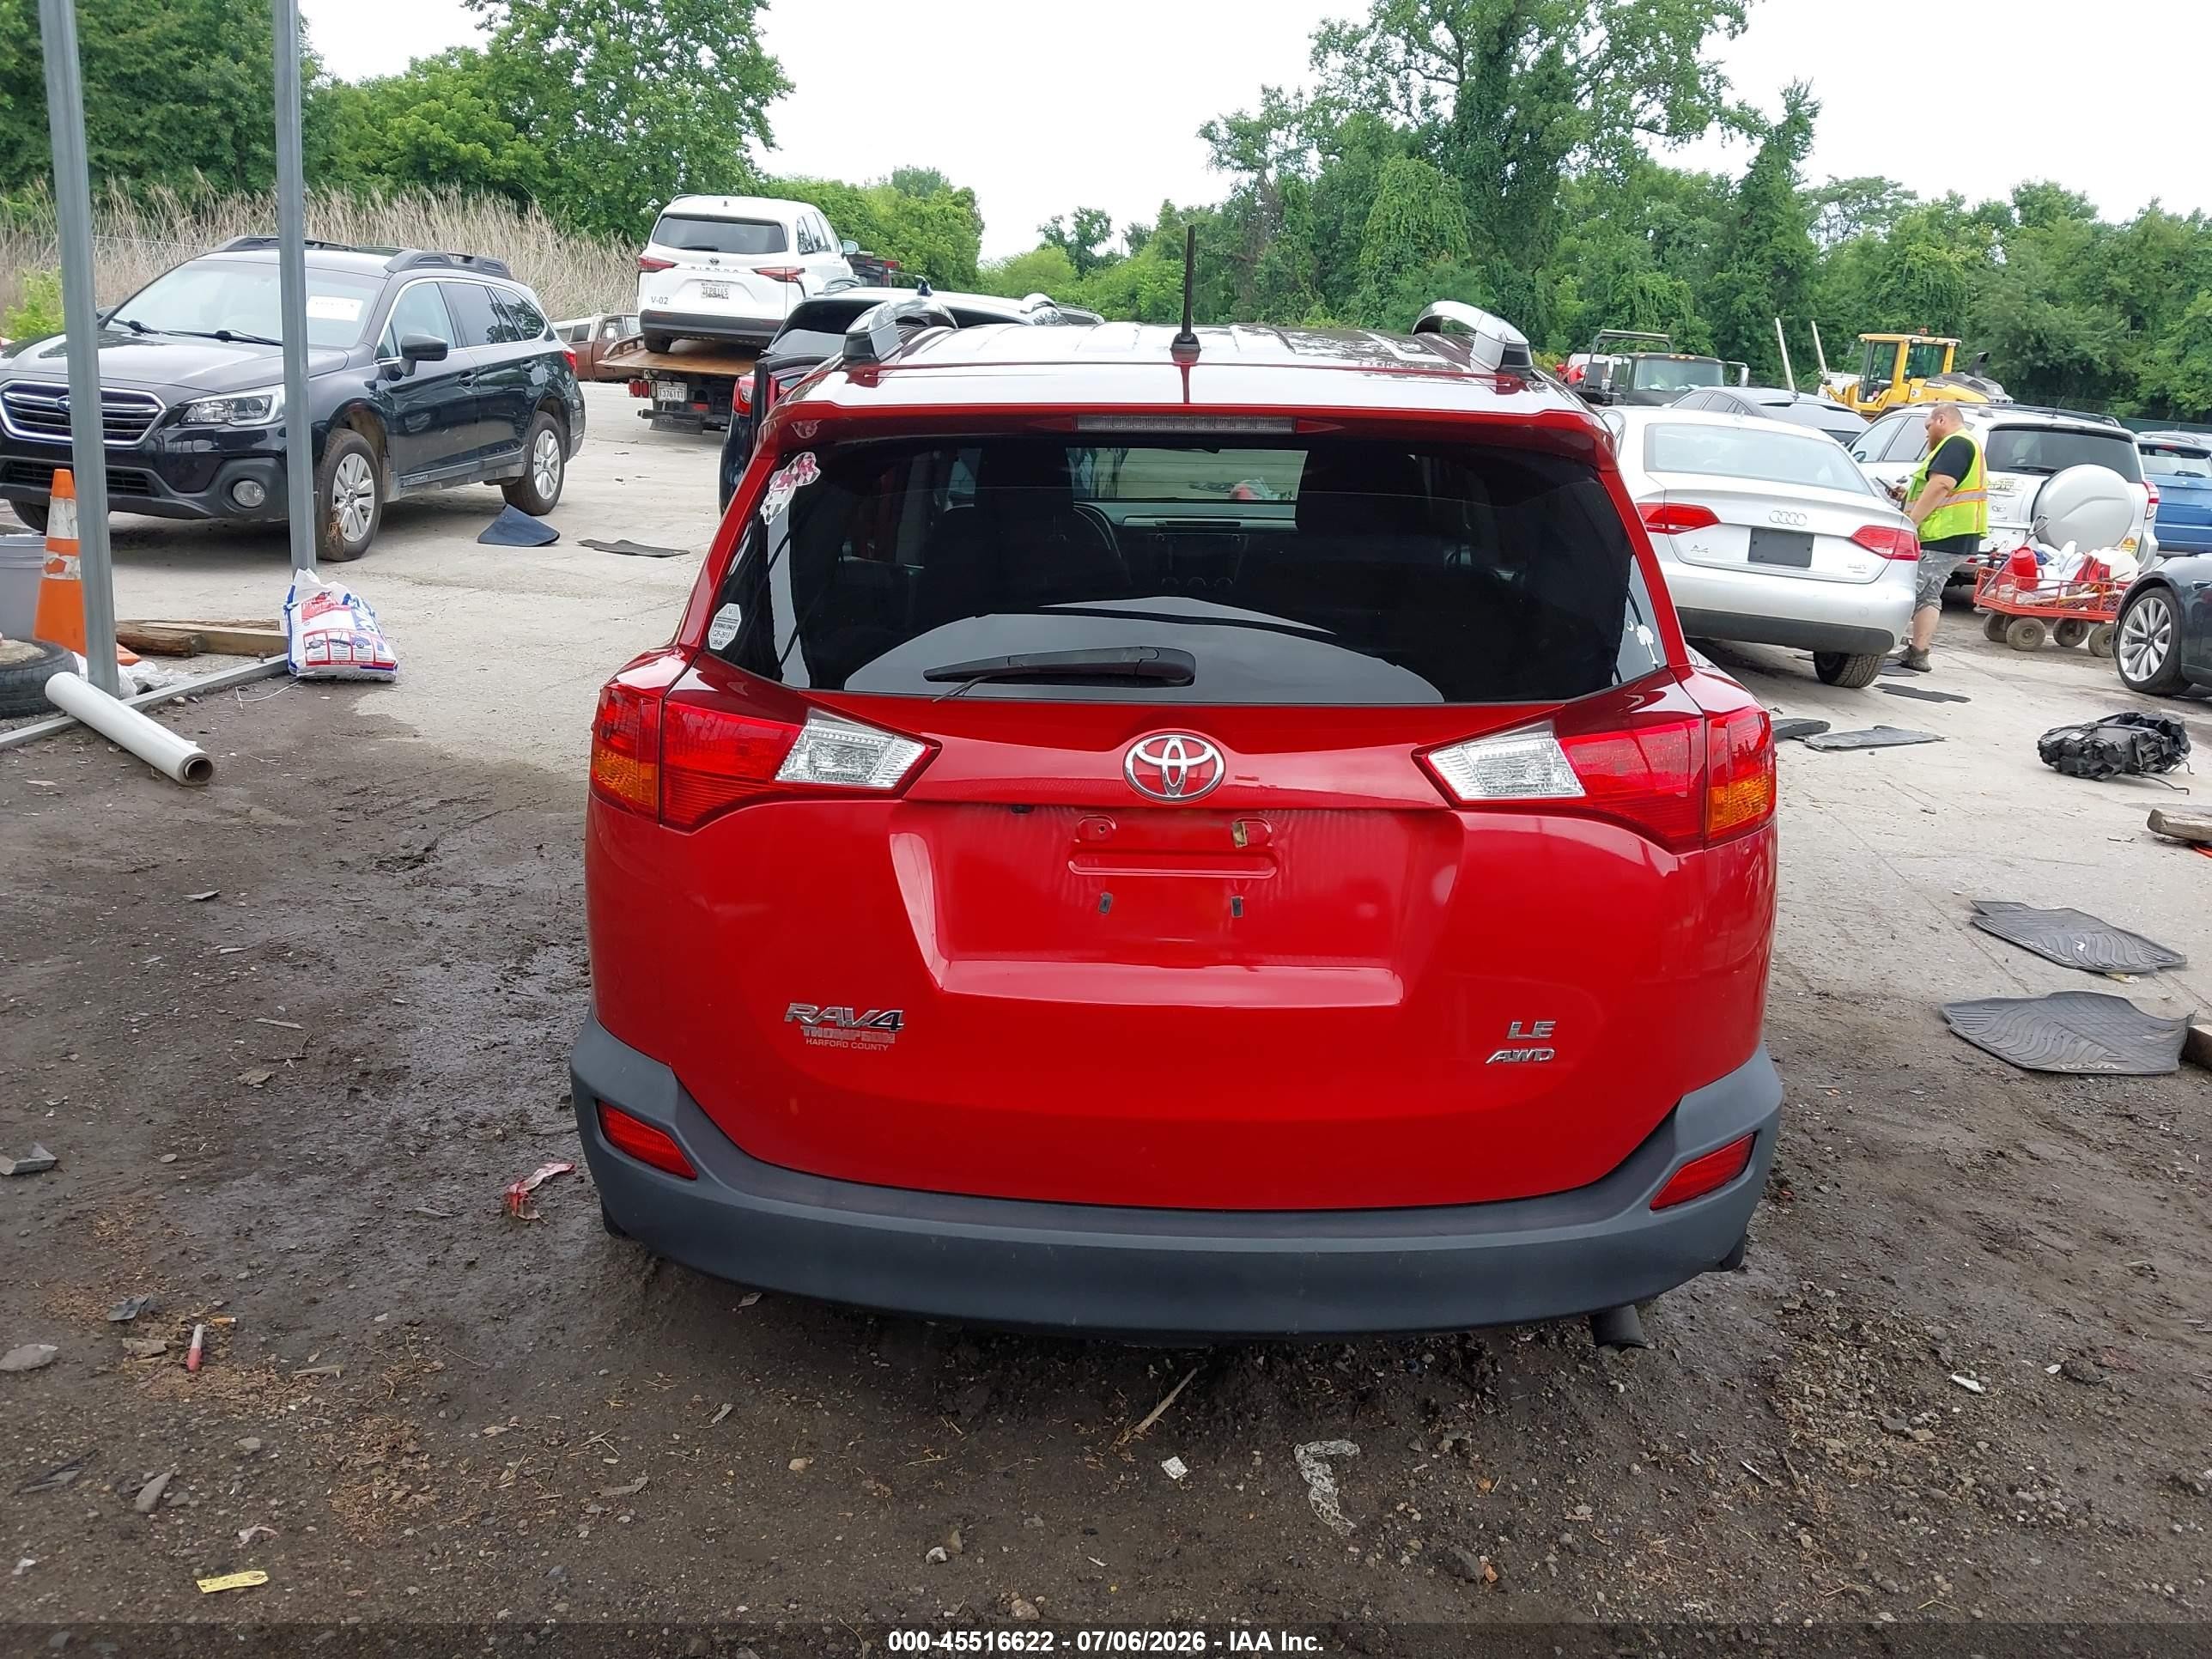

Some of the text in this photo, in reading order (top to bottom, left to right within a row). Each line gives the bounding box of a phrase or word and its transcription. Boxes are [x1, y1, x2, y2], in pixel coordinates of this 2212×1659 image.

[651, 295, 669, 305] V-02
[784, 1002, 905, 1031] RAV4
[1507, 1020, 1556, 1039] LE
[805, 1037, 889, 1051] HARFORD COUNTY
[1485, 1048, 1555, 1064] AWD
